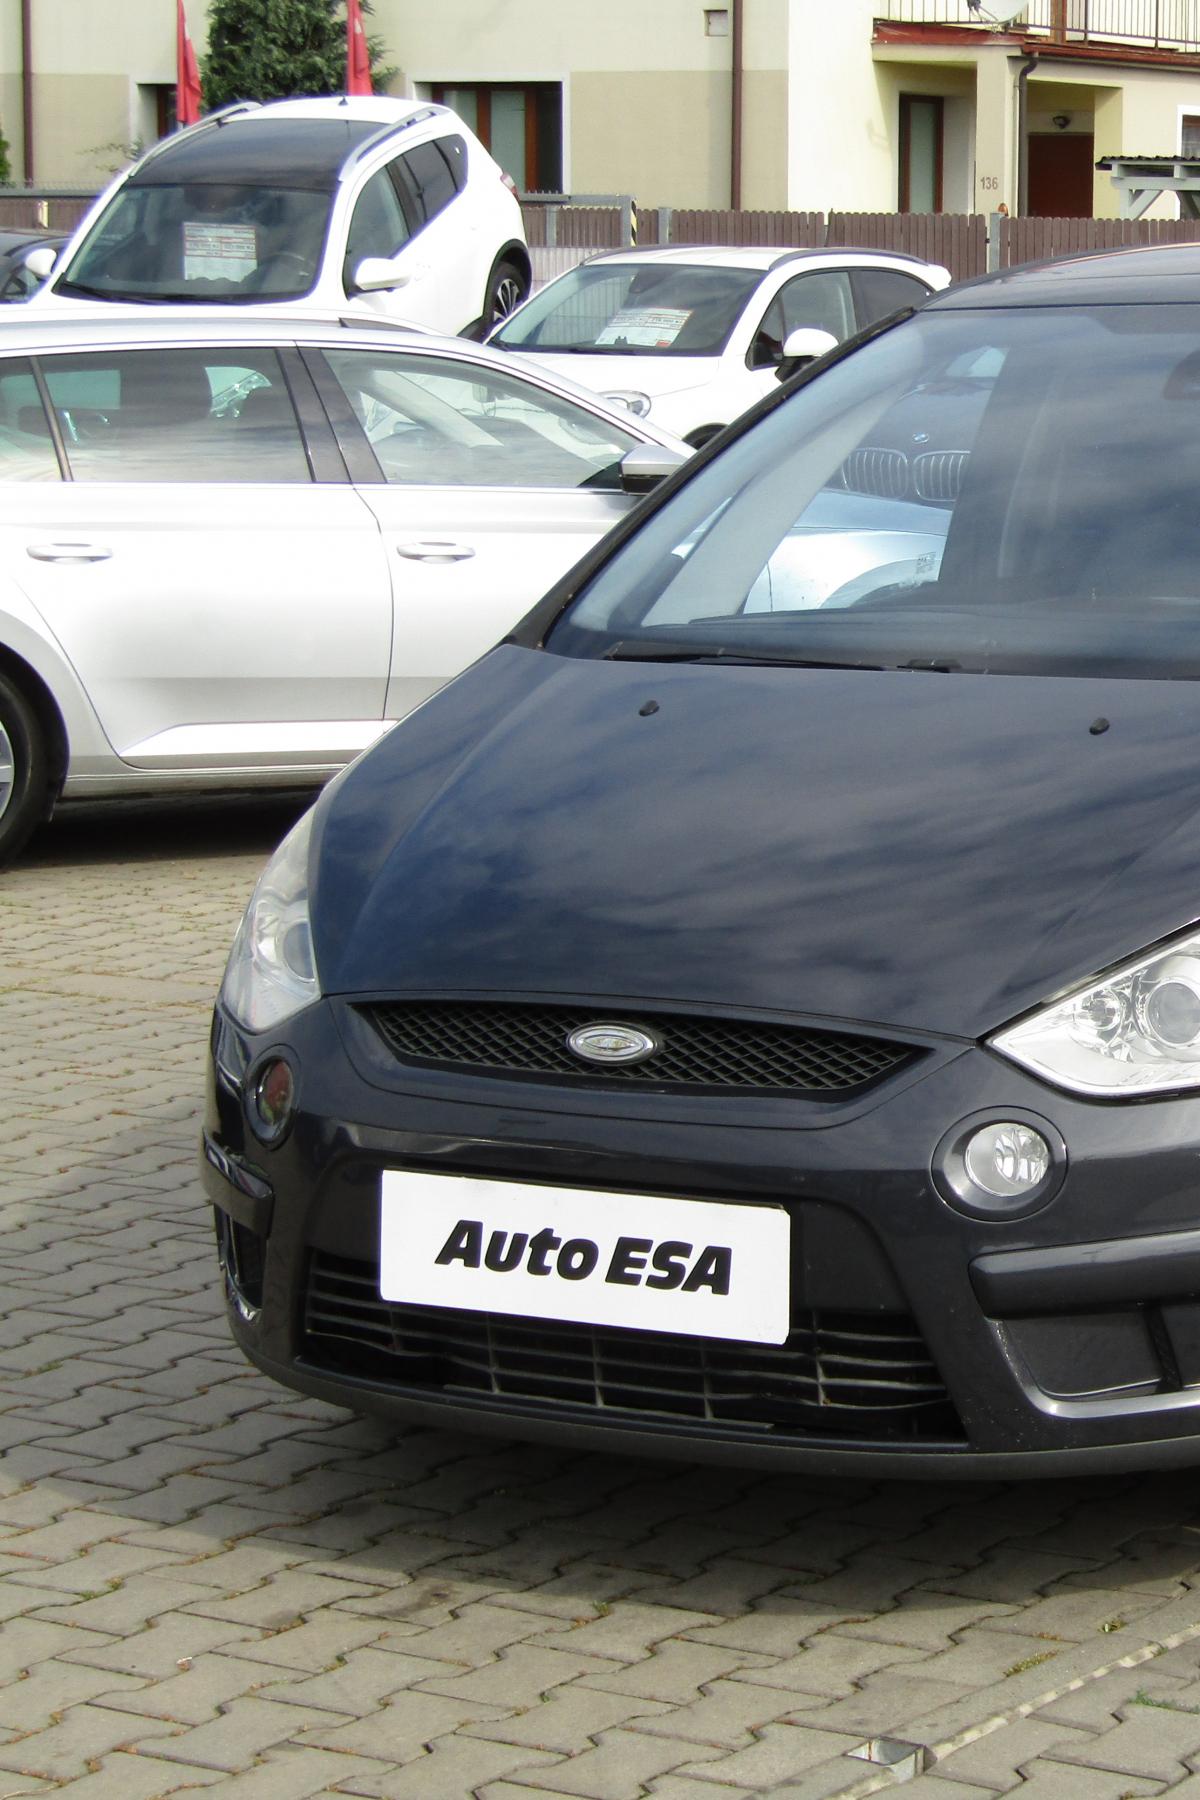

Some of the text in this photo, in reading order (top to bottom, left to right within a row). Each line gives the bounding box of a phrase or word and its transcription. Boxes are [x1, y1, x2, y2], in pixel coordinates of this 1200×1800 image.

[980, 176, 998, 190] 136
[434, 1219, 732, 1296] Auto ESA
